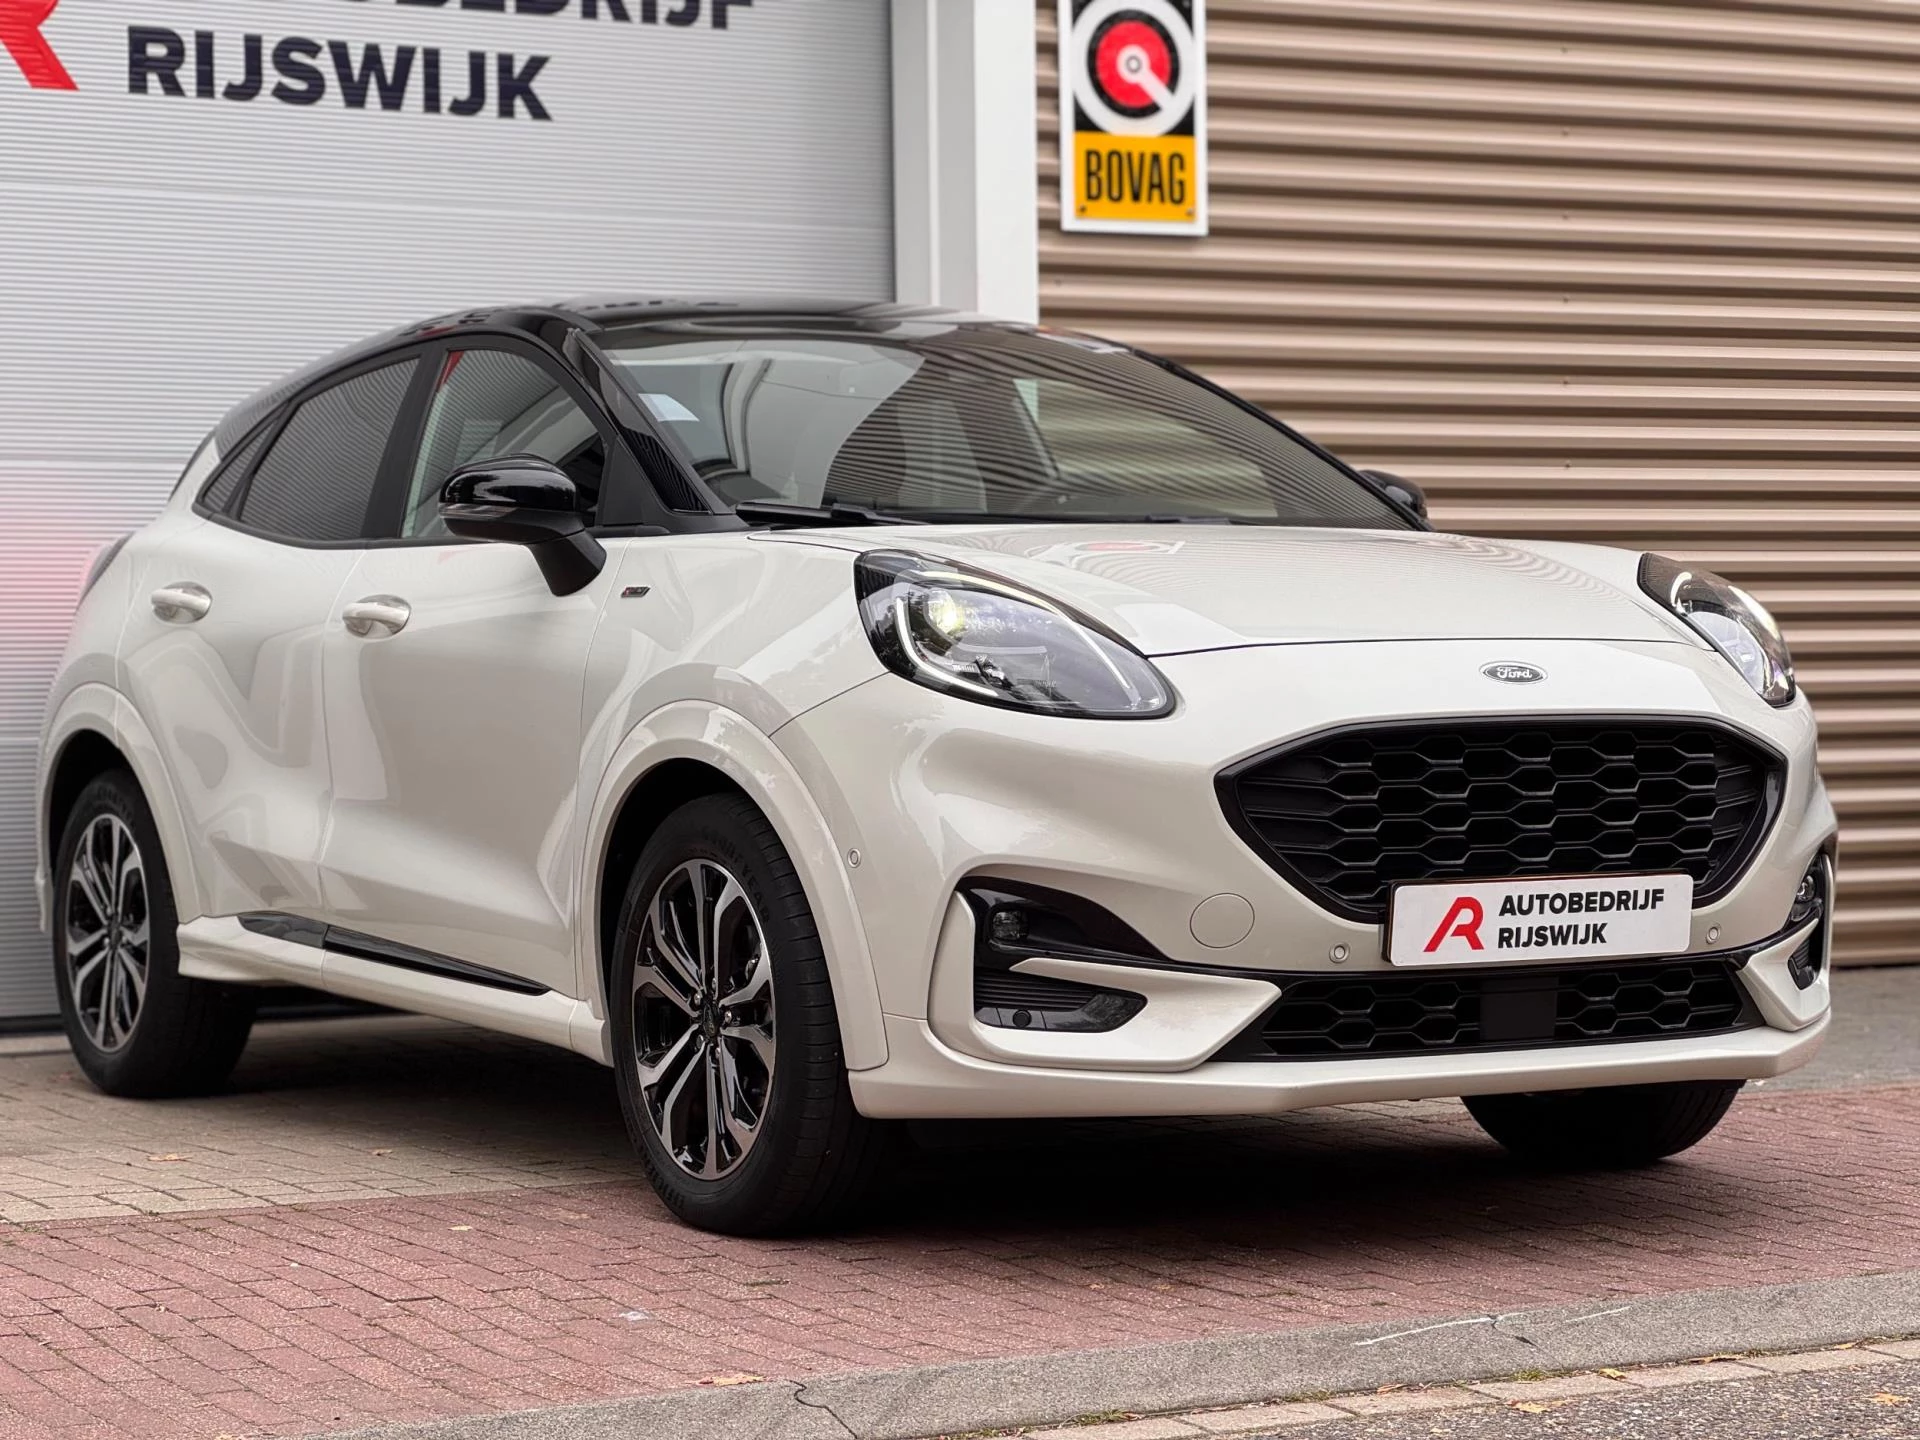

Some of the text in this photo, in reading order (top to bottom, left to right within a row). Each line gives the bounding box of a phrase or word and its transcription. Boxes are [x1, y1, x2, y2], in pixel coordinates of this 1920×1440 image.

[127, 25, 553, 121] RIJSWIJK
[1085, 149, 1186, 205] BOVAG
[1496, 666, 1533, 679] Ford
[1498, 888, 1665, 917] AUTOBEDRIJF
[1498, 922, 1608, 949] RIJSWIJK
